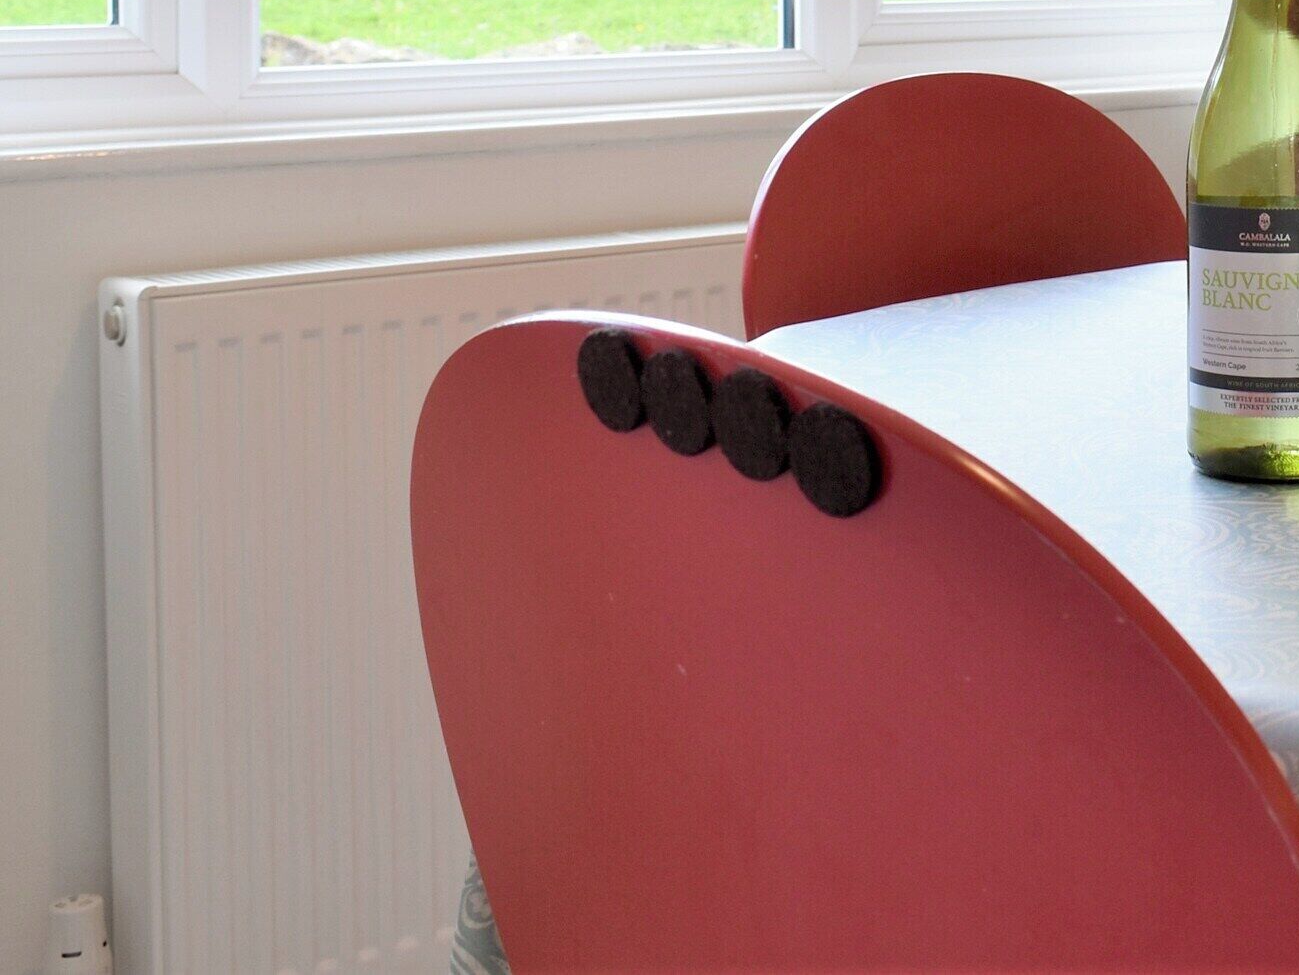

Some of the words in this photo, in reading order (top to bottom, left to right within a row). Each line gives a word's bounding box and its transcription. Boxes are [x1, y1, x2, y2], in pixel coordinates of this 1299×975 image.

[1239, 232, 1291, 241] CAMBALALA
[1202, 288, 1272, 311] BLANC
[1202, 358, 1227, 369] Western
[1228, 362, 1247, 370] Cape
[1220, 393, 1253, 403] EXPERTLY
[1224, 401, 1236, 409] THE
[1239, 403, 1265, 411] FINEST
